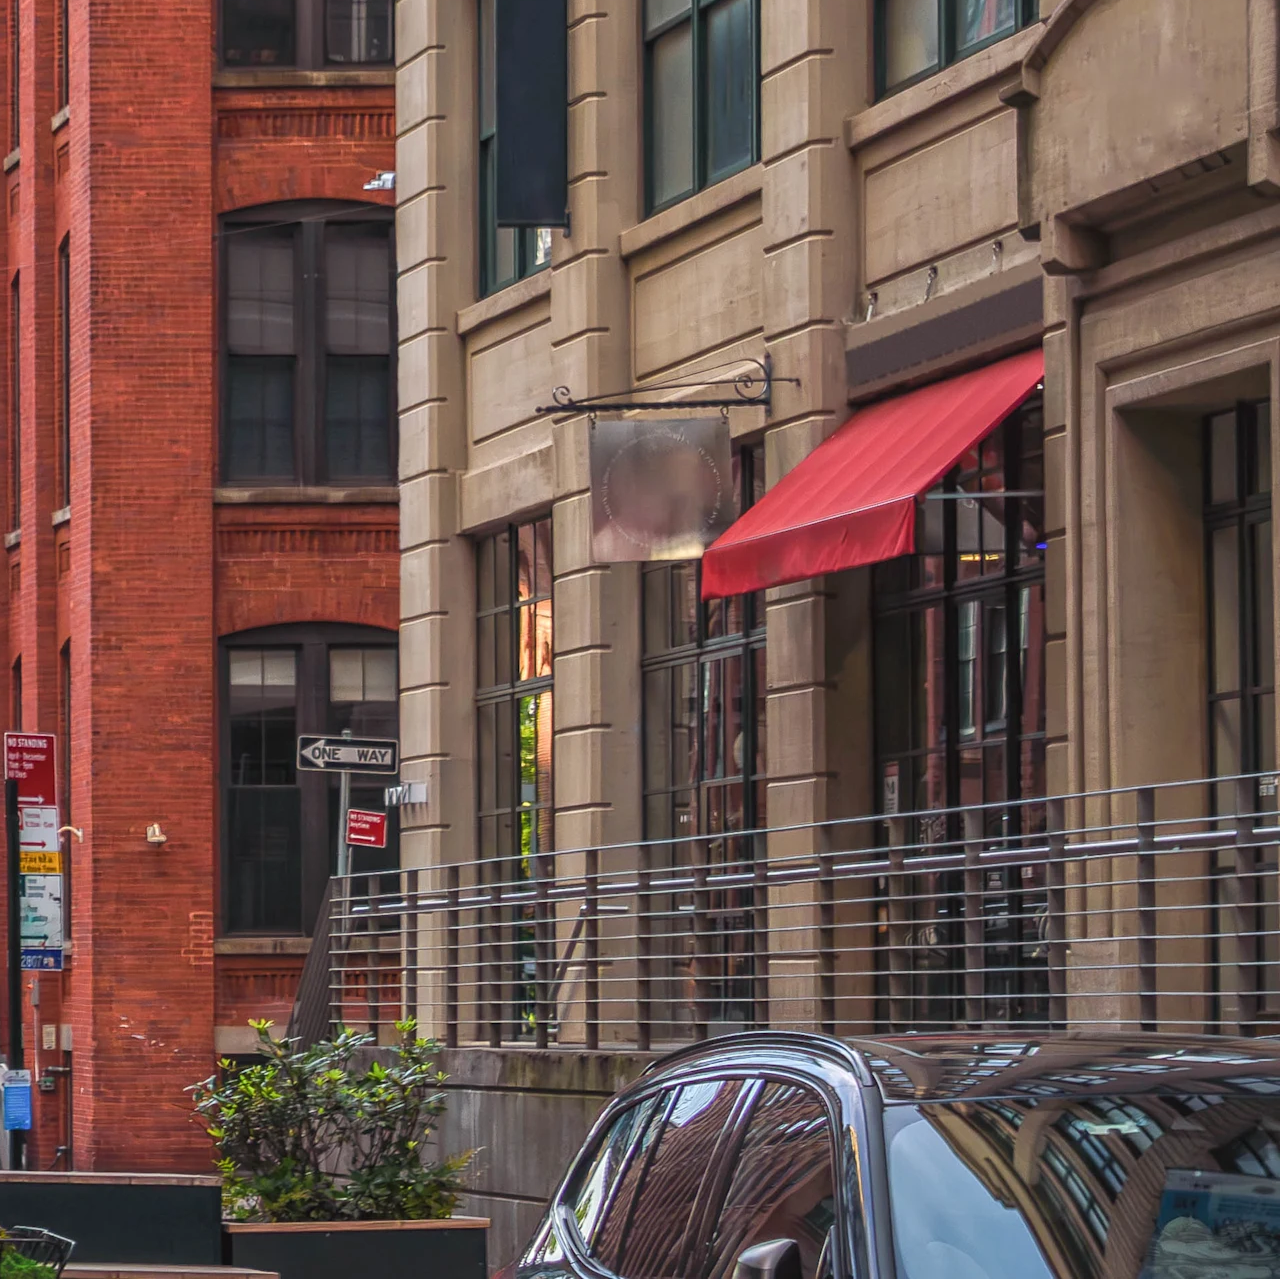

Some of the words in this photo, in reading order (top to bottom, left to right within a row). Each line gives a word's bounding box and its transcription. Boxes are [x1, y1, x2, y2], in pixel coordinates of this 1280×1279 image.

[7, 738, 17, 747] NO
[17, 738, 48, 749] STANDING
[312, 747, 341, 760] ONE
[357, 749, 389, 763] WAY
